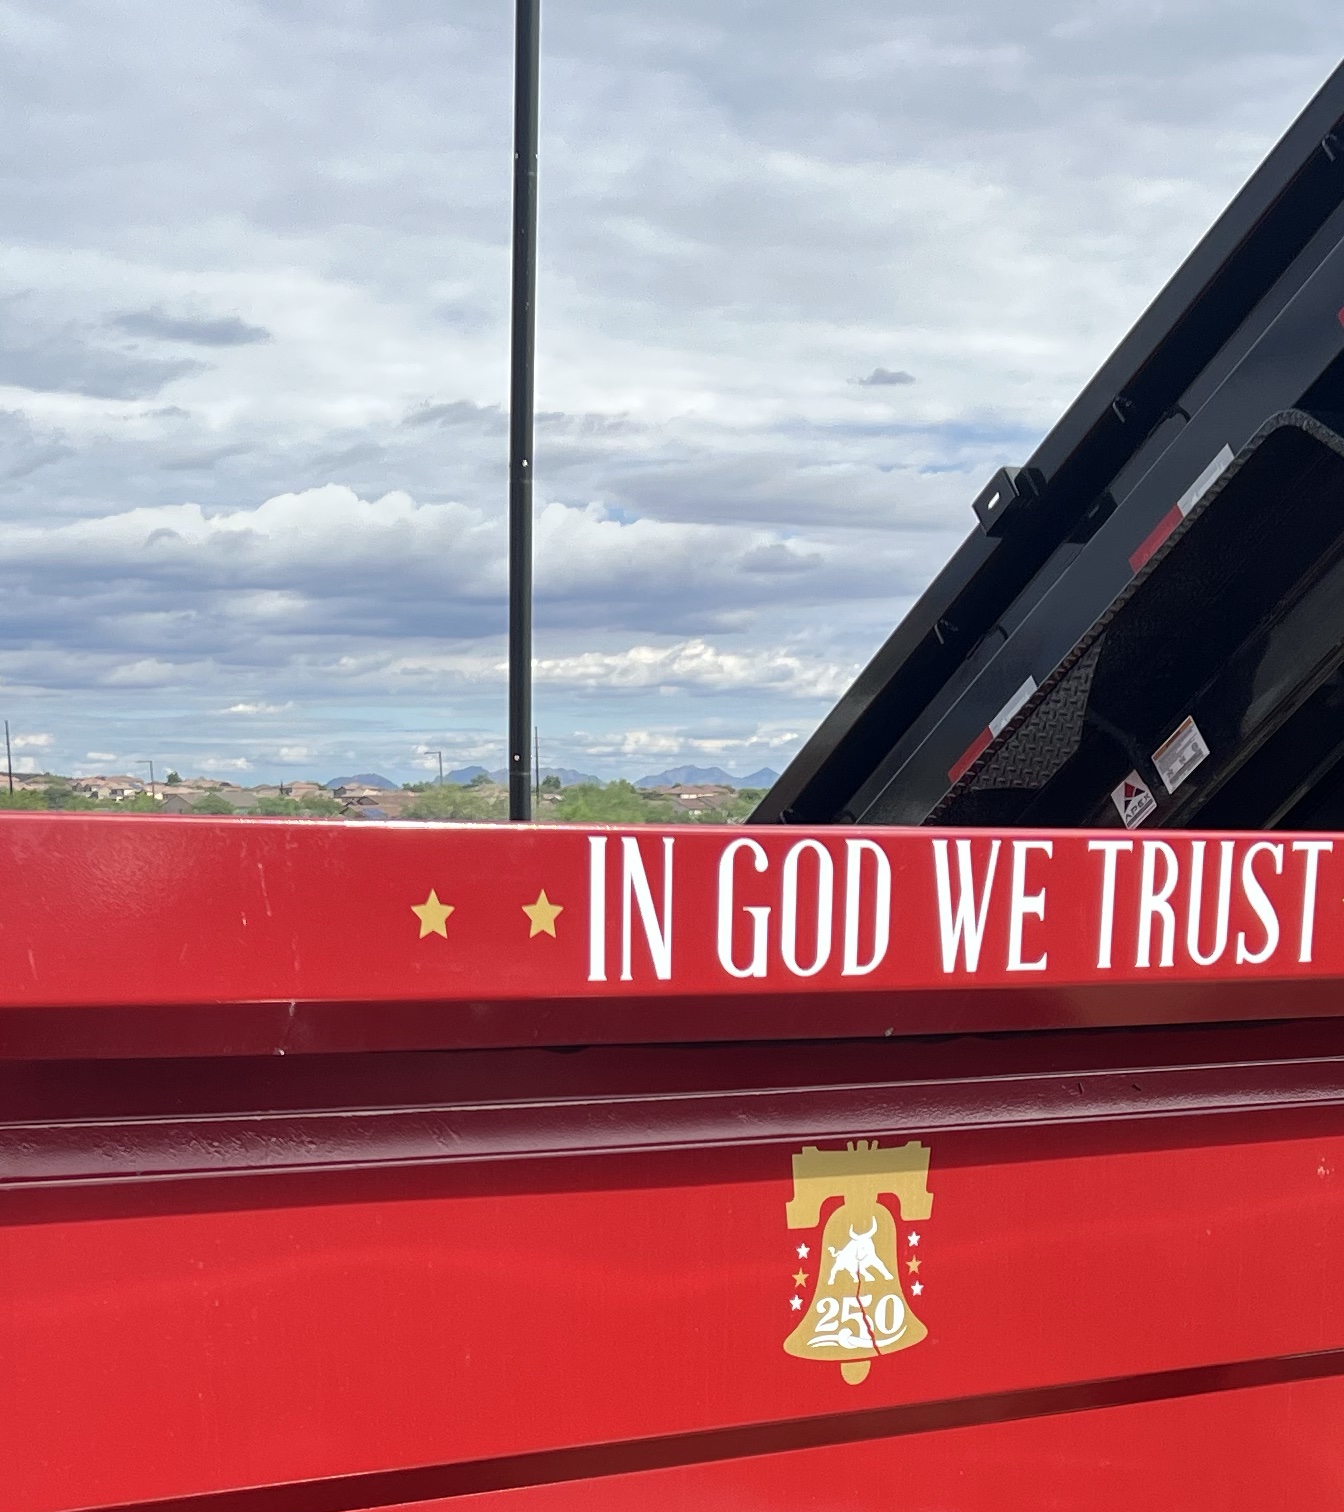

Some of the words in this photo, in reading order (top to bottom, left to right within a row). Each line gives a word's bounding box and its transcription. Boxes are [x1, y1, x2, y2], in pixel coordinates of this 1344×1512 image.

[1125, 793, 1151, 822] APEX
[586, 836, 676, 982] IN
[717, 838, 893, 978] GOD
[930, 839, 1054, 973] WE
[1087, 840, 1334, 969] TRUST
[814, 1294, 905, 1347] 250
